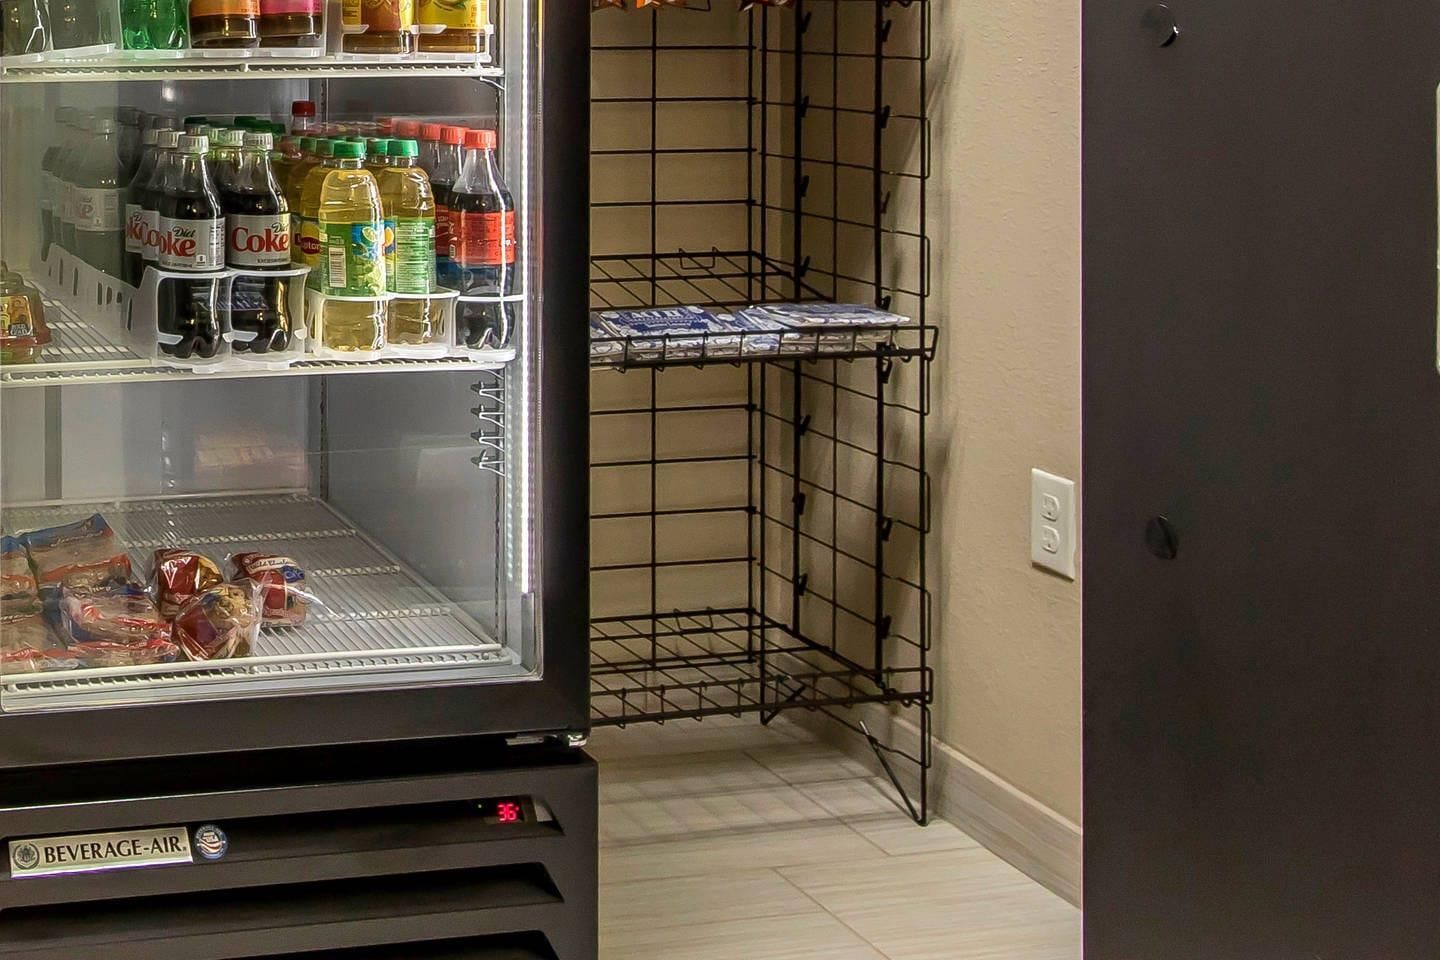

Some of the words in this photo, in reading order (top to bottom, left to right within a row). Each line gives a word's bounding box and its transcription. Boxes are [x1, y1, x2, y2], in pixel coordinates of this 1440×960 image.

[160, 232, 197, 258] oke
[172, 226, 197, 238] Diet
[231, 227, 289, 253] Coke
[497, 803, 518, 821] 36
[45, 836, 183, 864] BEVERAGE-AIR
